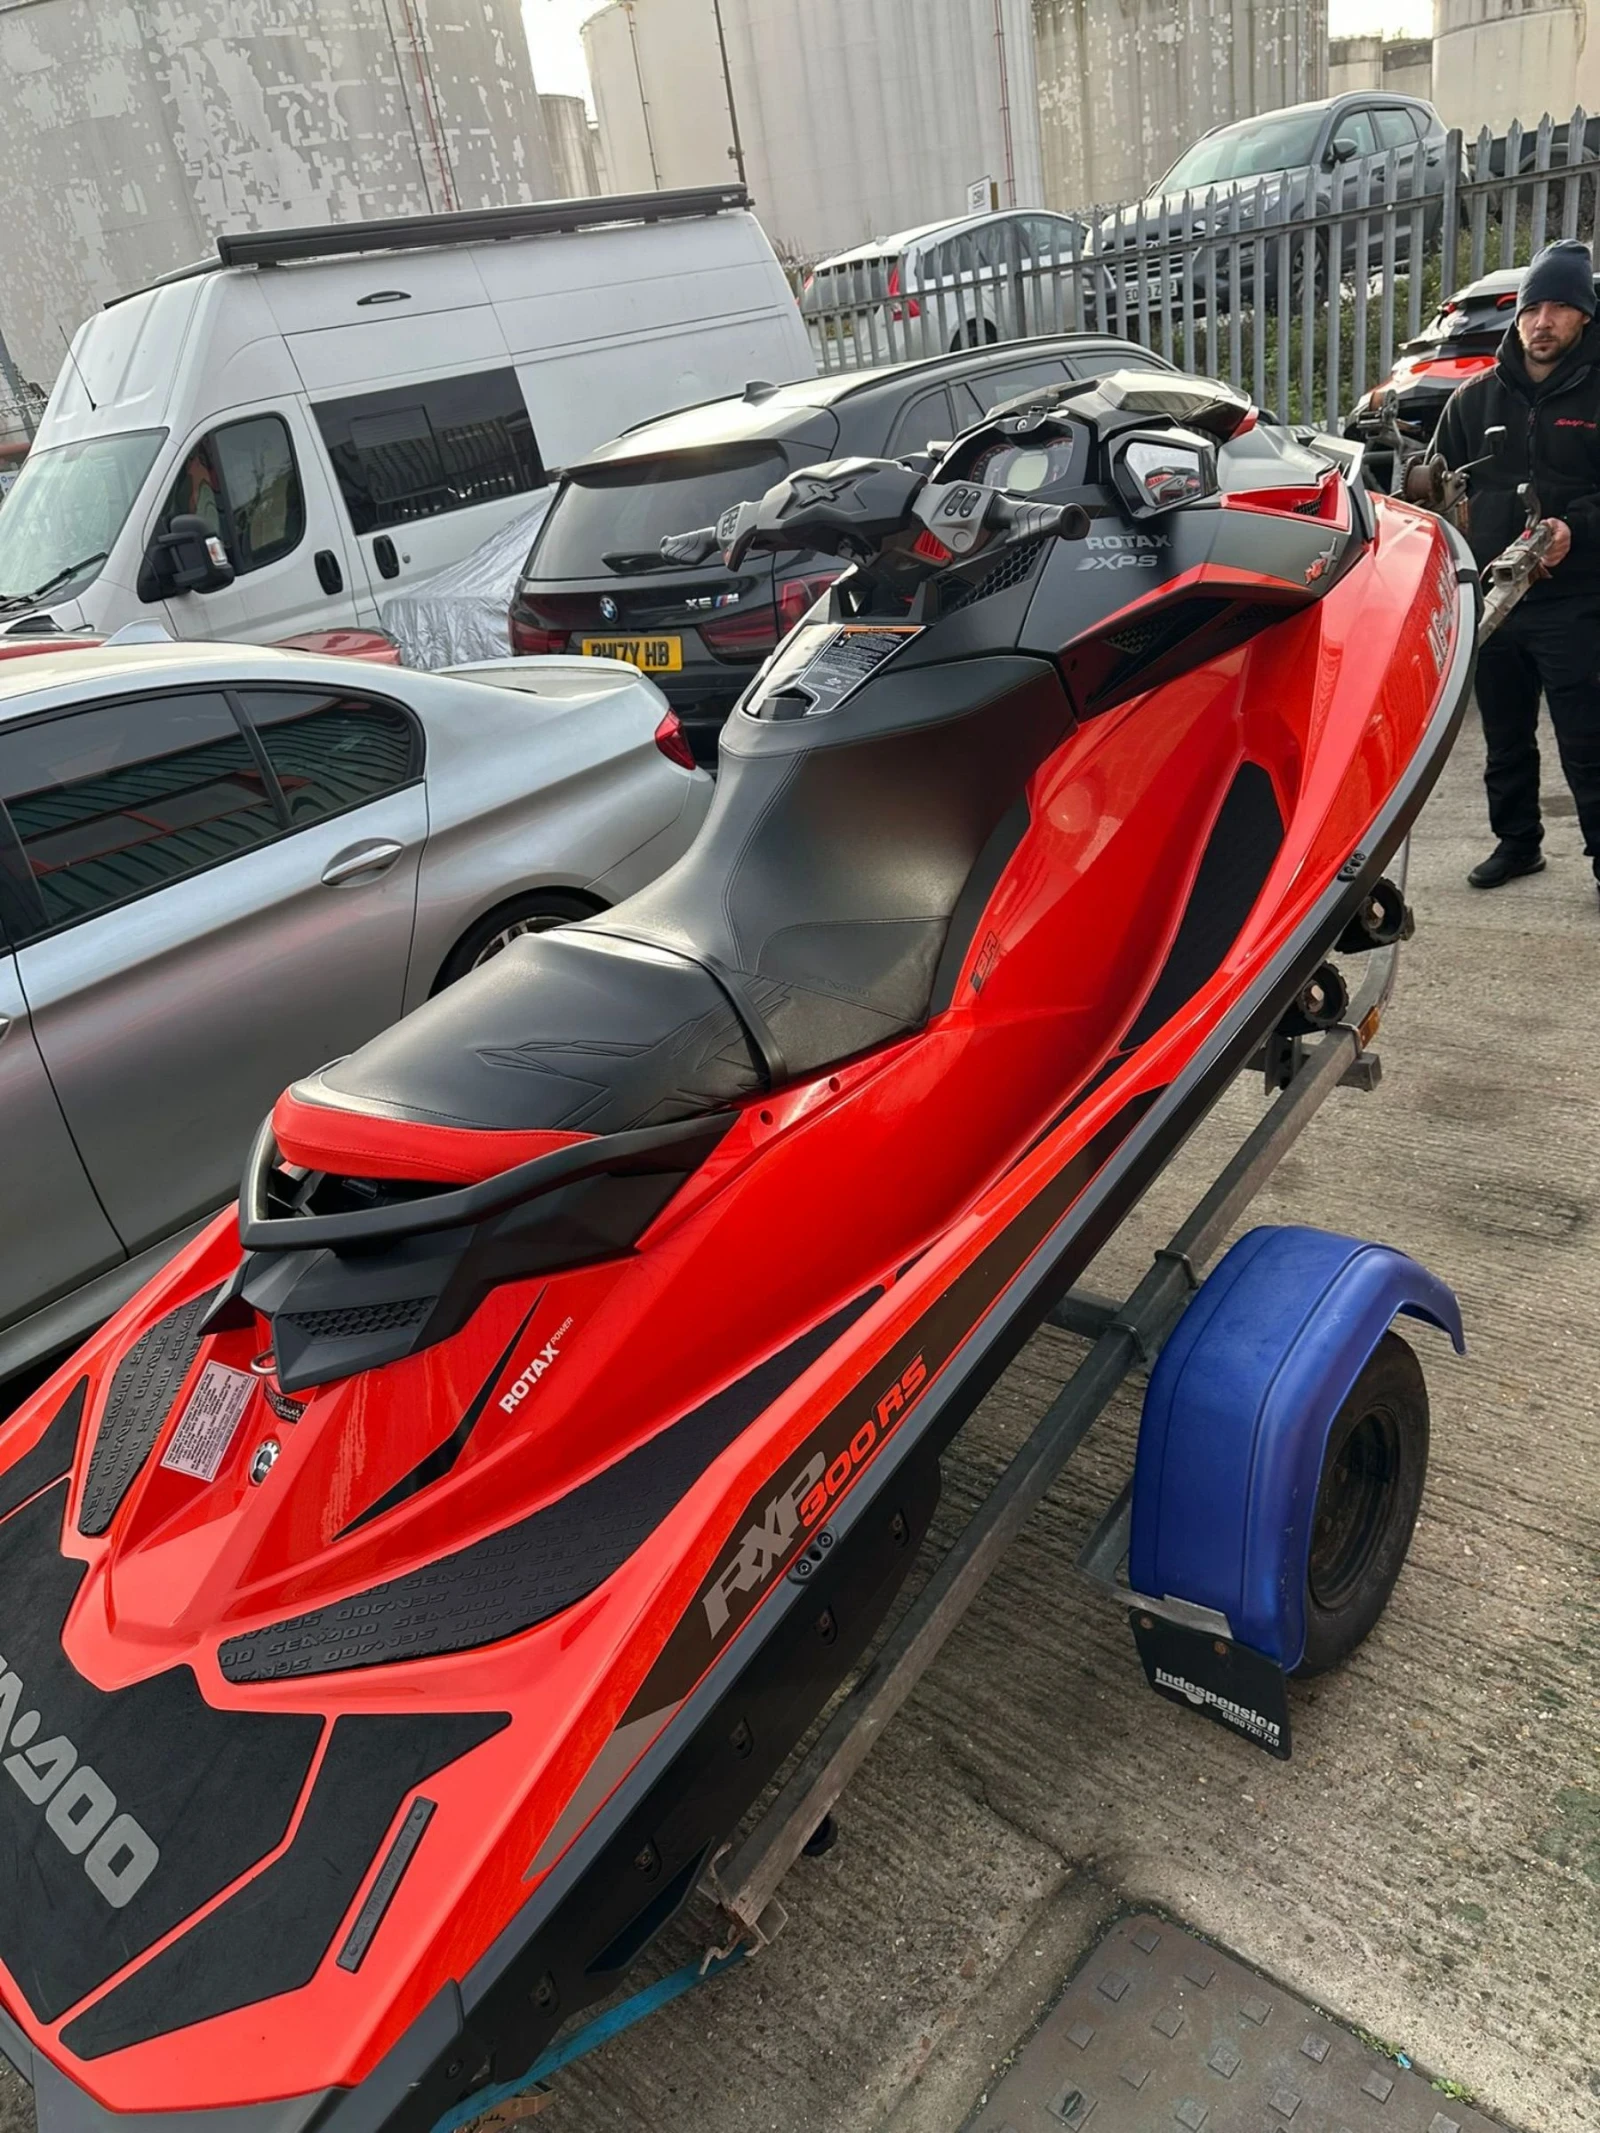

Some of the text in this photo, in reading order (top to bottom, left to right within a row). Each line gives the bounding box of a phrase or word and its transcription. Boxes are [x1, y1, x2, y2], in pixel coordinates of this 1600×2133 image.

[1086, 534, 1172, 551] ROTAX
[645, 642, 669, 667] HB
[498, 1316, 574, 1414] ROTAX POWER
[800, 1354, 928, 1527] 300 RS
[702, 1451, 826, 1640] RXP
[1155, 1667, 1280, 1735] Indespension
[1222, 1711, 1280, 1747] 0800 720 720
